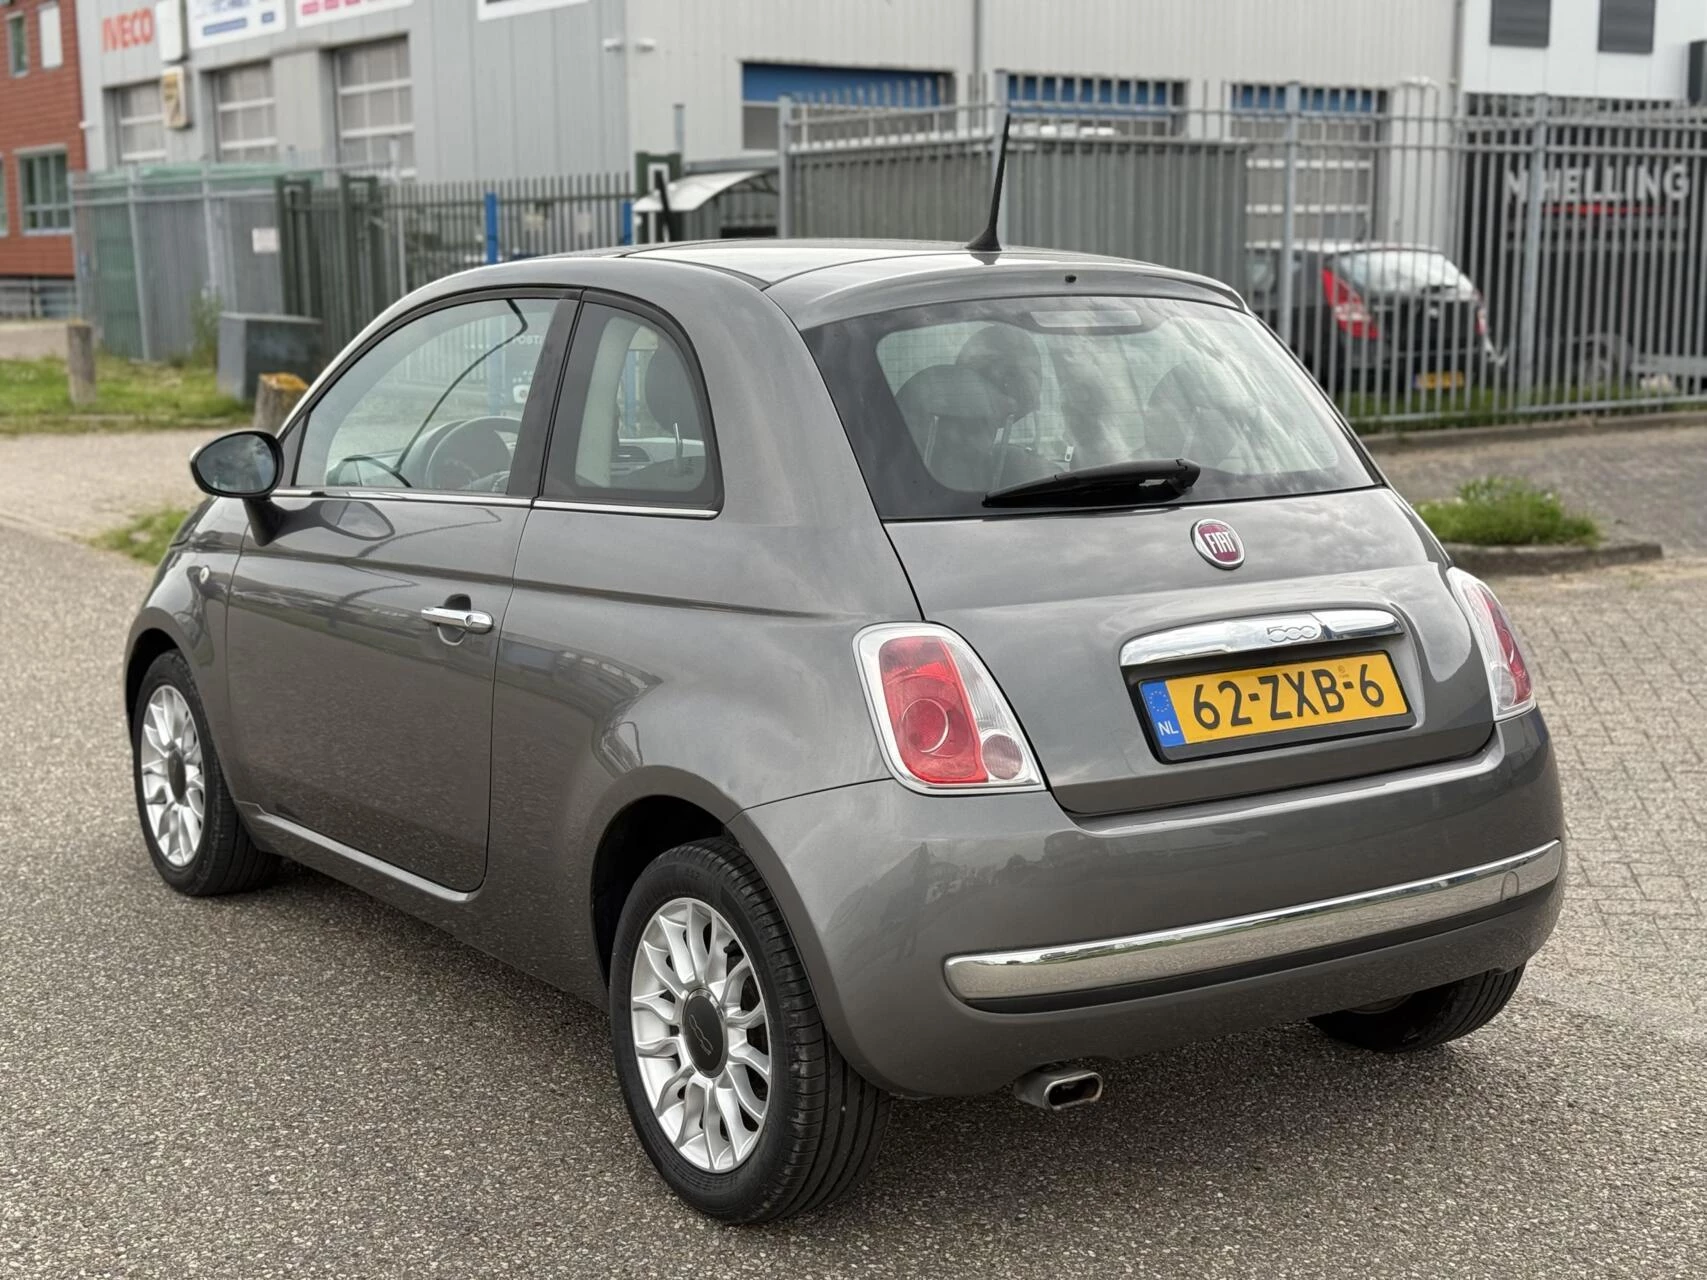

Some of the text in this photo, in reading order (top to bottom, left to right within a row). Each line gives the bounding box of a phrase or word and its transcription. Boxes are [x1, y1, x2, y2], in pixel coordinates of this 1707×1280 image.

[102, 9, 154, 51] IVECO
[1204, 531, 1236, 556] FIAT
[1265, 624, 1317, 643] 500
[1193, 663, 1385, 731] 62-ZXB-6
[1158, 721, 1180, 737] NL
